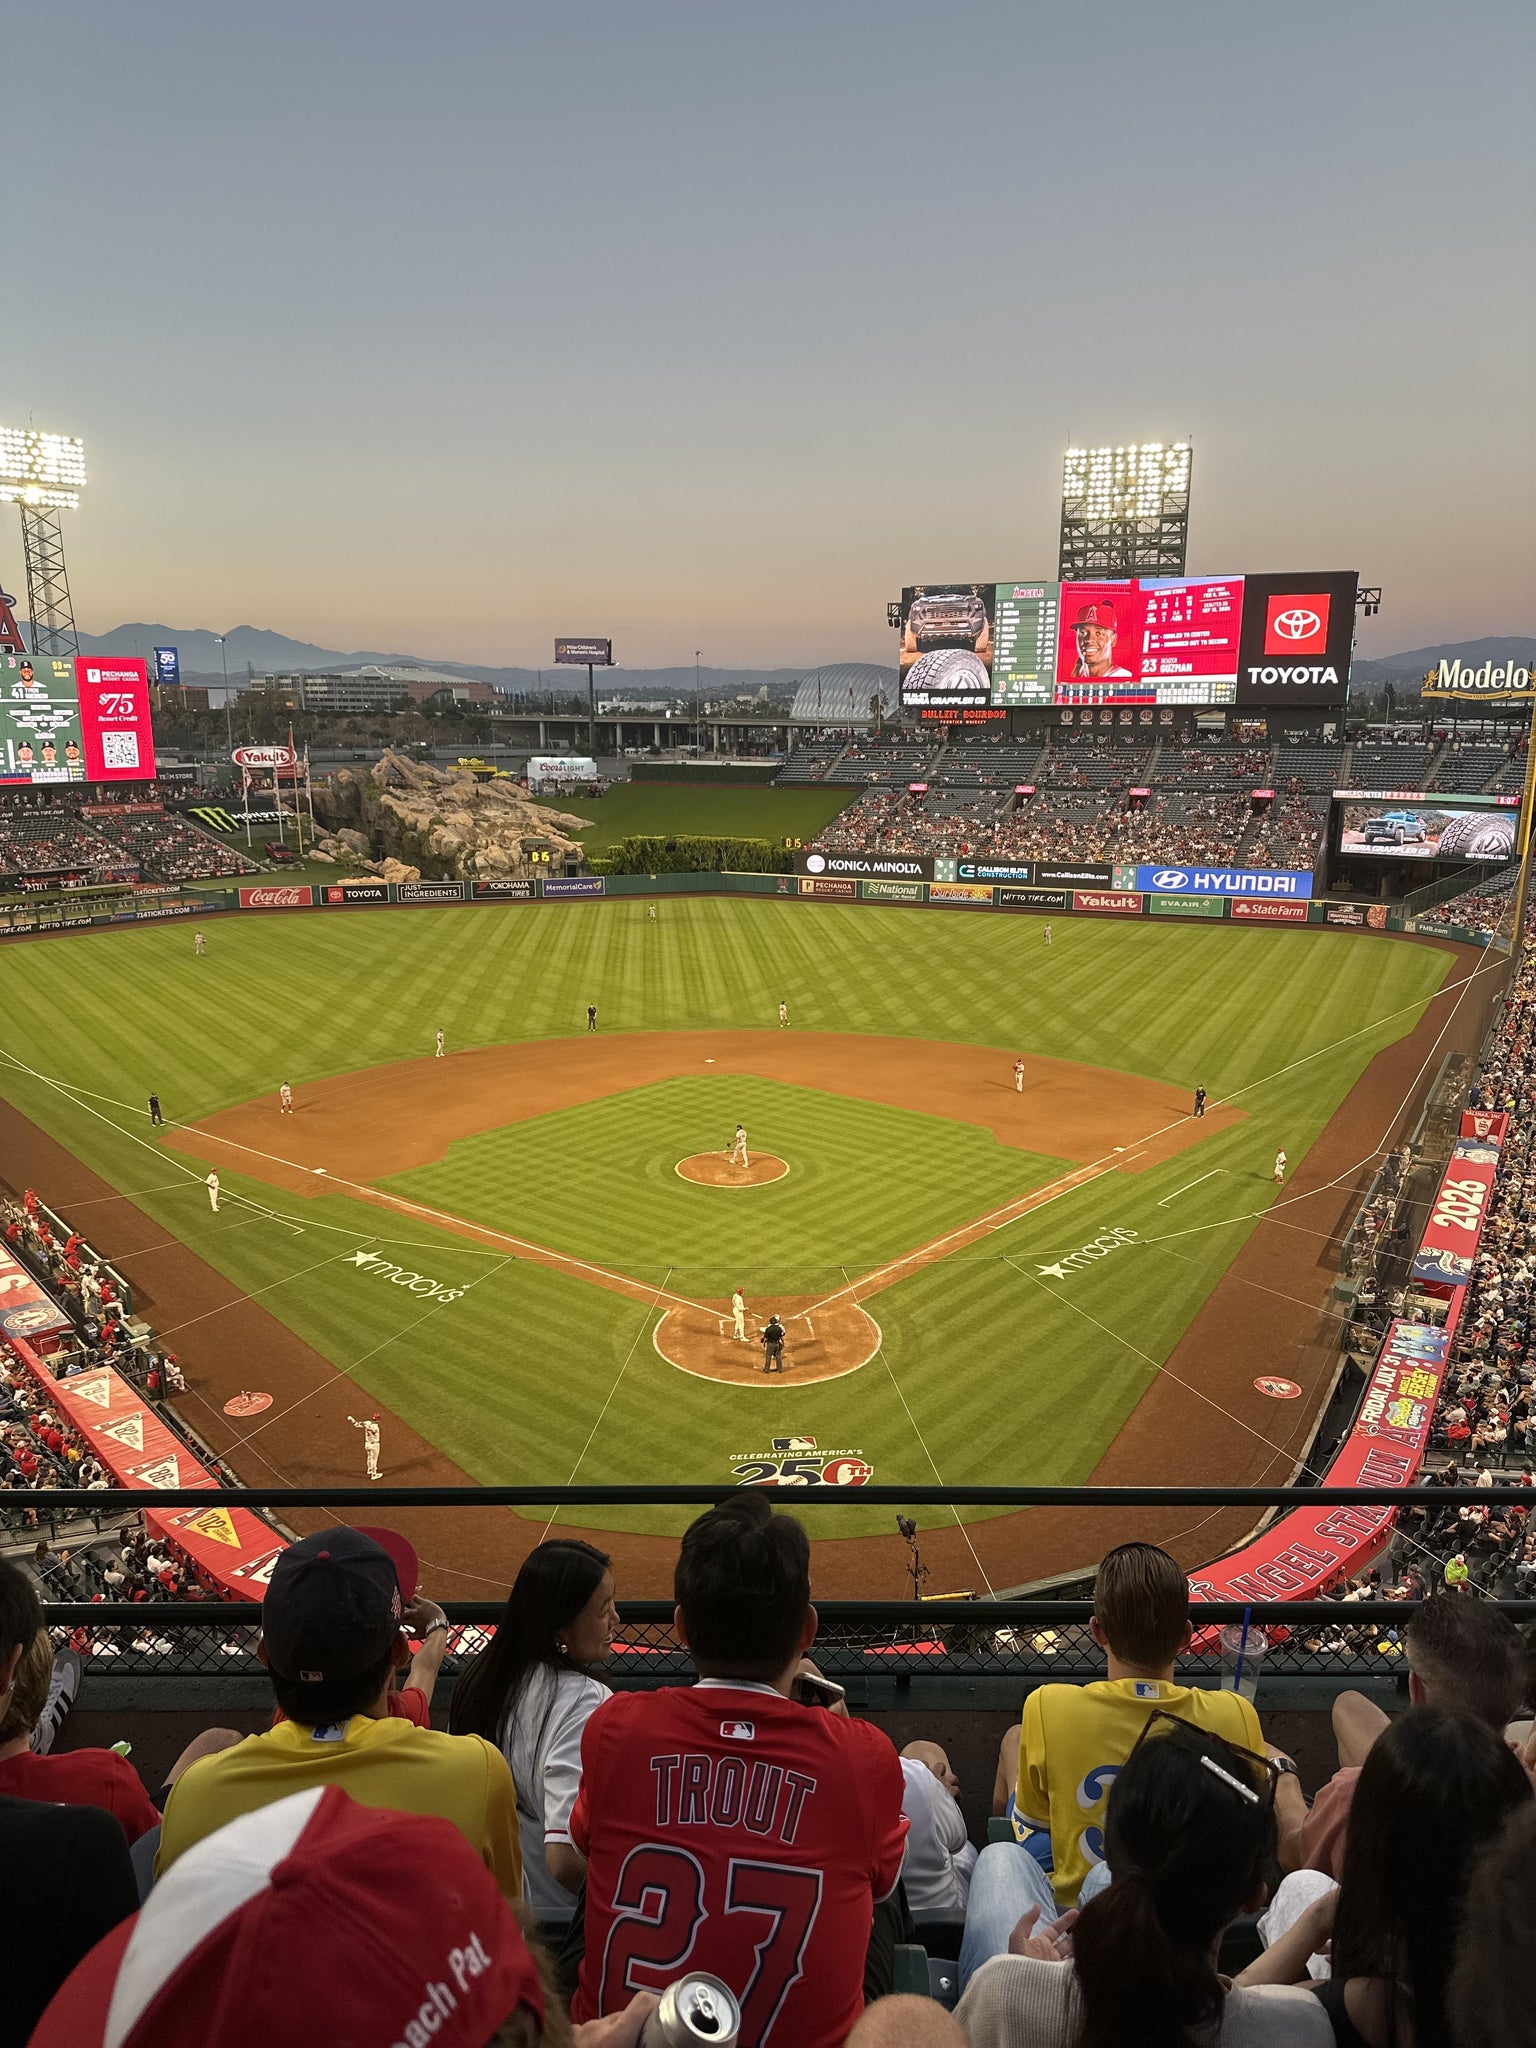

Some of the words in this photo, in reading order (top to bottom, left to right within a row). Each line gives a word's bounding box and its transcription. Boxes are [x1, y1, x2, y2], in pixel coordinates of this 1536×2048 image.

[1013, 586, 1043, 598] ANGELS
[1141, 659, 1157, 673] 23
[1160, 663, 1192, 673] GUZMAN
[1247, 666, 1339, 684] TOYOTA
[1437, 659, 1528, 689] Modelo
[99, 692, 134, 713] $75
[244, 752, 287, 762] Yakult
[1371, 846, 1416, 855] GRAPPLER
[828, 859, 871, 872] KONICA
[872, 862, 923, 874] MINOLTA
[977, 872, 1028, 880] CONSTRUCTION
[1194, 872, 1296, 892] HYUNDAI
[545, 883, 593, 891] MemorialCare
[815, 882, 852, 890] PECHANGA
[879, 884, 918, 895] National
[933, 887, 969, 898] Surfside
[346, 889, 382, 898] TOYOTA
[404, 889, 458, 898] INGREDIENTS
[1002, 893, 1026, 901] NITTO
[1028, 894, 1064, 904] TIRE.COM
[1078, 895, 1139, 908] Yakult
[39, 922, 60, 930] NITTO
[61, 917, 92, 927] TIRE.COM
[1418, 924, 1448, 934] FMB.com
[1432, 1178, 1487, 1231] 2026
[1382, 1354, 1402, 1366] 31
[1374, 1364, 1398, 1388] JULY
[1406, 1367, 1430, 1400] JERSEY
[729, 1451, 802, 1461] CELEBRATING
[805, 1448, 864, 1457] AMERICA'S
[1188, 1542, 1339, 1603] ANGEL
[650, 1754, 817, 1845] TROUT
[599, 1842, 824, 2048] 27
[448, 1931, 493, 1994] Pat
